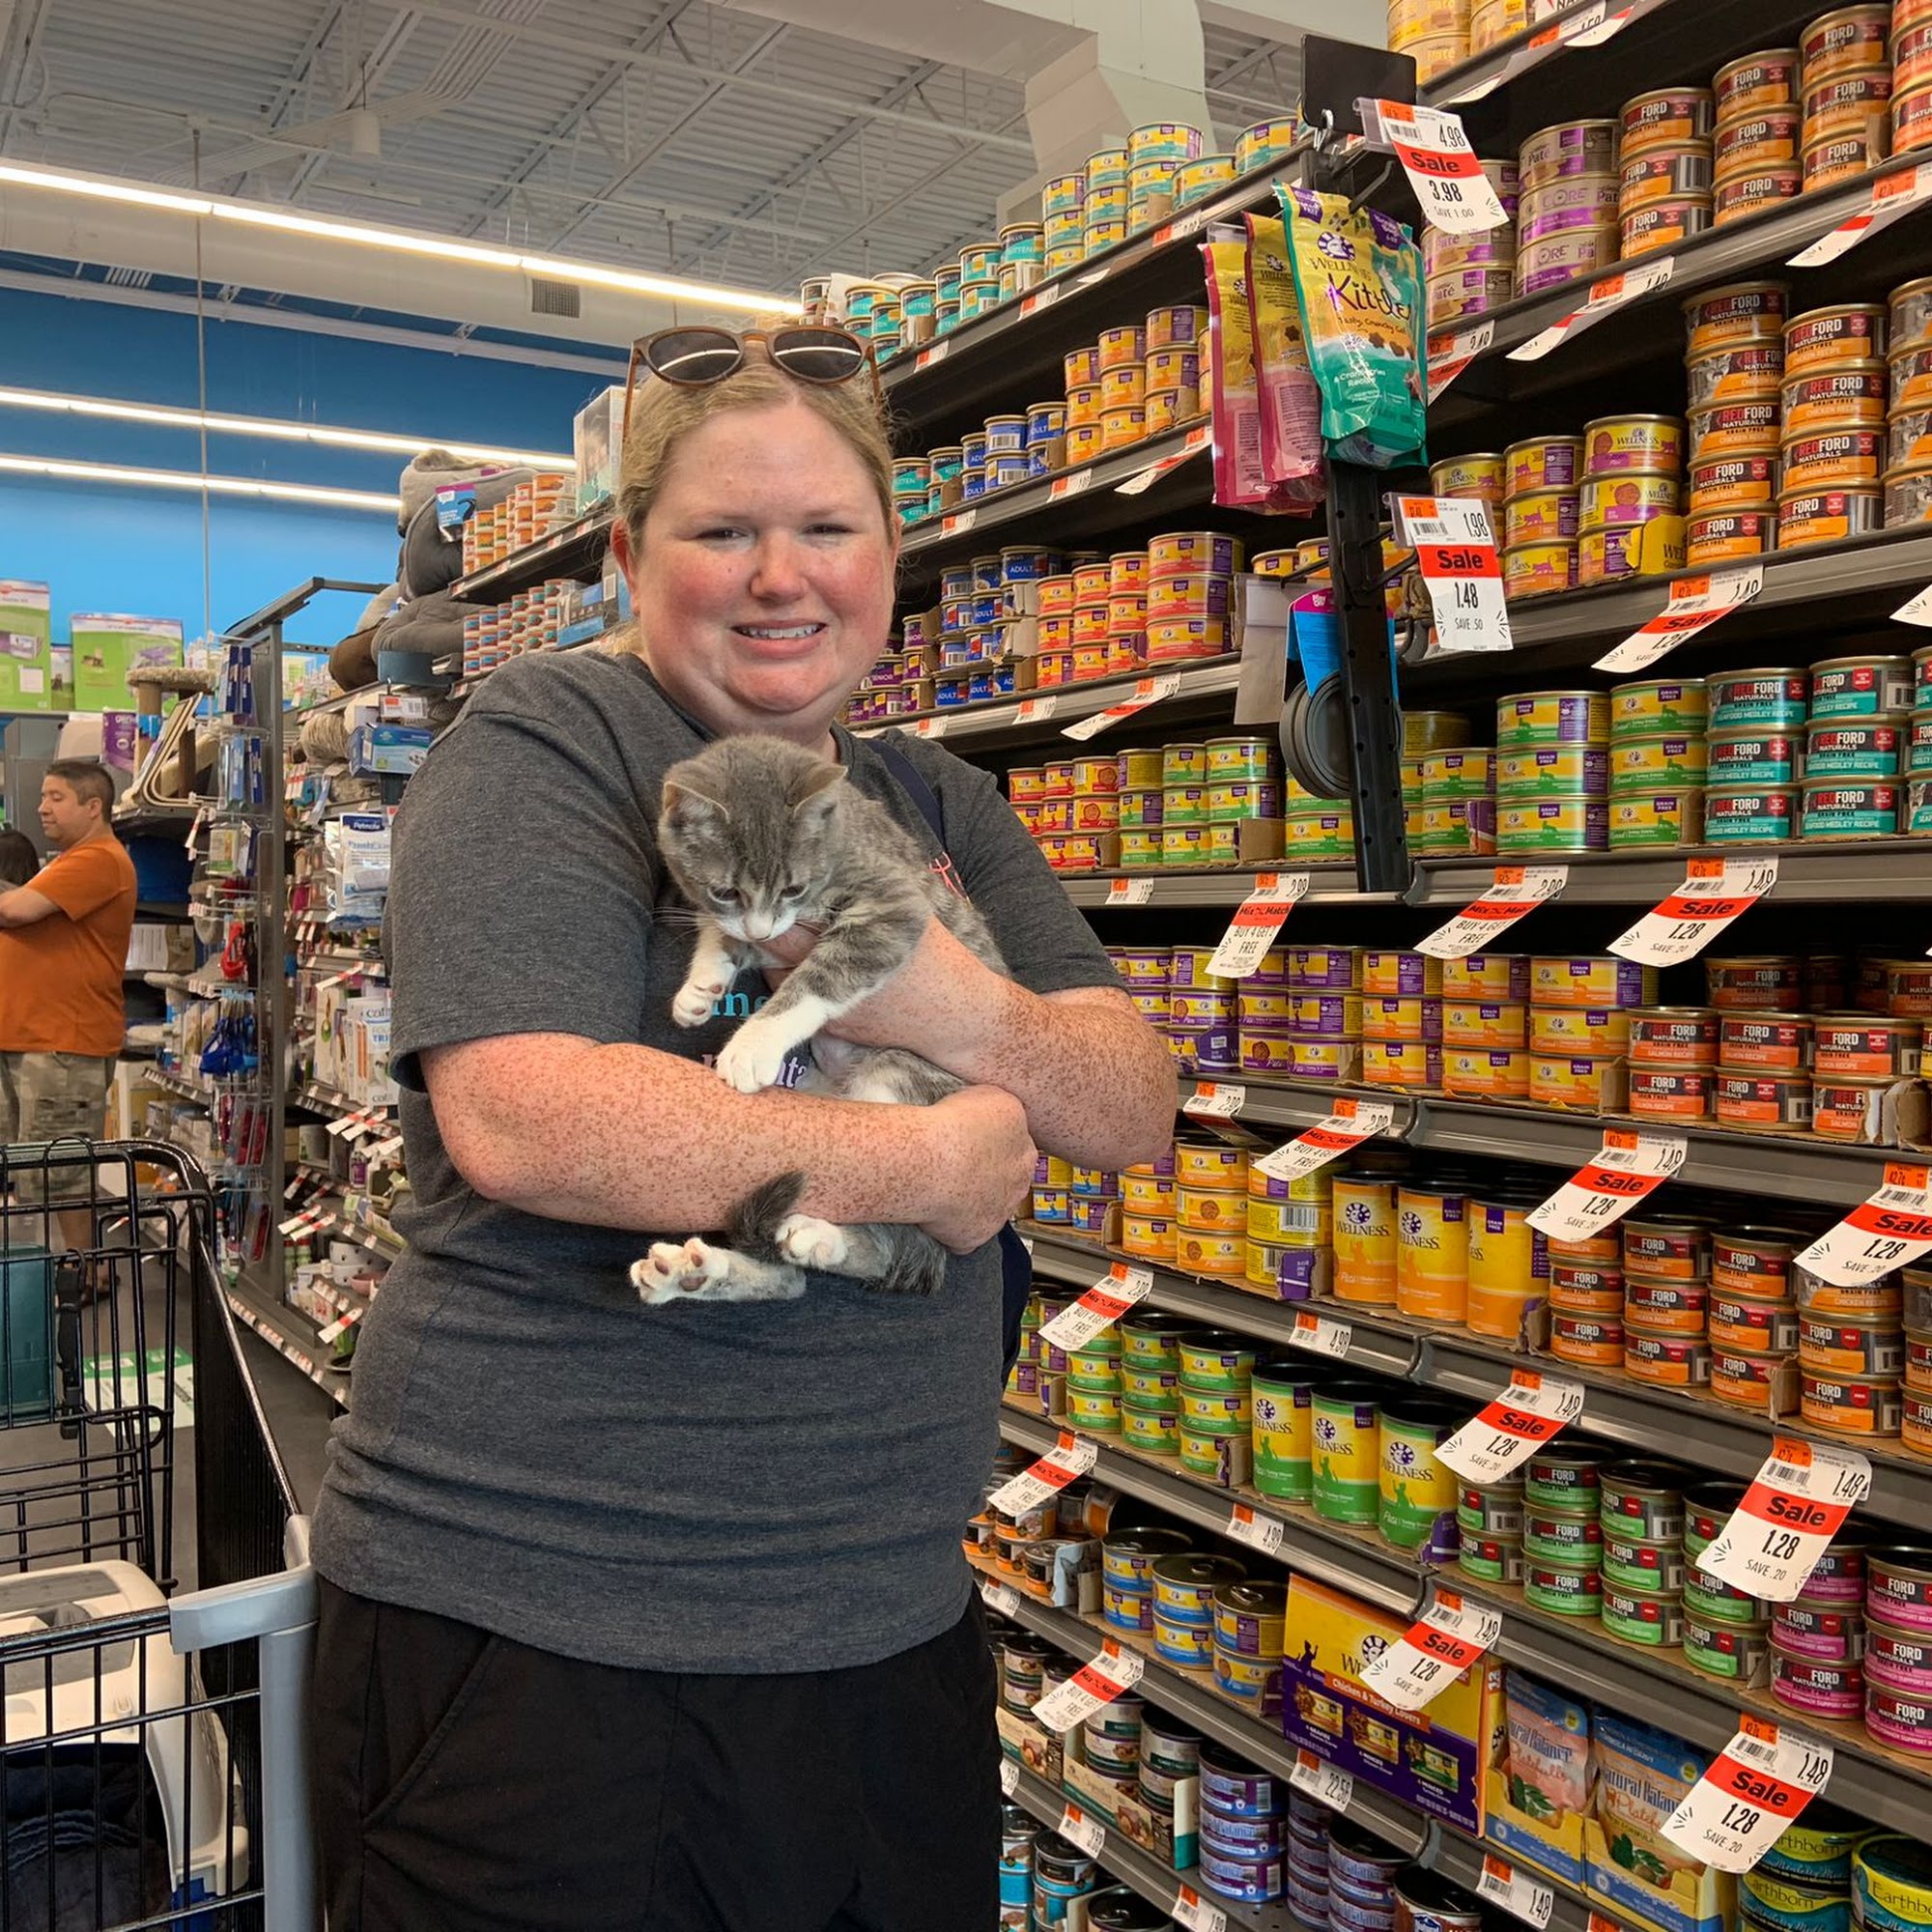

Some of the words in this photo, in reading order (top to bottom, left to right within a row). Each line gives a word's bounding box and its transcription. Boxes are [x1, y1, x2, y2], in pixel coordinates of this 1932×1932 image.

[1438, 125, 1466, 149] 4.98
[1410, 152, 1462, 173] Sale
[1429, 180, 1463, 203] 3.98
[1434, 205, 1454, 218] SAVE
[1454, 207, 1475, 218] 1.00
[1711, 307, 1753, 321] NATURALS
[1794, 320, 1843, 340] REDFORD
[1795, 333, 1834, 348] NATURALS
[1809, 377, 1864, 393] REDFORD
[1808, 390, 1857, 402] NATURALS
[1722, 406, 1774, 420] REDFORD
[1722, 419, 1766, 429] NATURALS
[1616, 435, 1660, 448] WELLNESS
[1800, 436, 1851, 455] REDFORD
[1799, 449, 1842, 464] NATURALS
[1699, 463, 1745, 482] REDFORD
[1463, 512, 1490, 539] 1.98
[1436, 549, 1483, 570] Sale
[1009, 564, 1035, 575] ADULT
[1454, 582, 1479, 609] 1.48
[1454, 618, 1473, 630] SAVE
[1663, 611, 1719, 630] Sale
[935, 689, 958, 700] ADULT
[1733, 682, 1782, 696] REDFORD
[1733, 694, 1775, 702] NATURALS
[1818, 730, 1865, 747] REDFORD
[1717, 742, 1761, 758] REDFORD
[1818, 742, 1858, 752] NATURALS
[1717, 753, 1752, 762] NATURALS
[1716, 798, 1760, 814] REDFORD
[1816, 790, 1865, 808] REDFORD
[1816, 802, 1857, 810] NATURALS
[1715, 809, 1752, 817] NATURALS
[1239, 905, 1254, 916] Mix
[1264, 905, 1290, 916] Match
[1467, 902, 1490, 917] Mix
[1678, 901, 1736, 917] Sale
[1234, 925, 1250, 938] BUY
[1455, 919, 1477, 930] BUY
[1667, 922, 1707, 940] 1.28
[1459, 932, 1489, 944] FREE
[1238, 941, 1259, 955] FREE
[1649, 943, 1674, 954] SAVE
[1652, 1024, 1697, 1037] REDFORD
[1652, 1034, 1690, 1042] NATURALS
[1307, 1127, 1325, 1141] Mix
[1293, 1144, 1311, 1155] BUY
[1293, 1157, 1320, 1170] FREE
[1593, 1172, 1644, 1192] Sale
[1580, 1196, 1618, 1216] 1.28
[1336, 1224, 1390, 1237] WELLNESS
[1563, 1216, 1585, 1230] SAVE
[1873, 1213, 1932, 1236] Sale
[1399, 1233, 1440, 1250] ELLNESS
[1861, 1237, 1908, 1261] 1.28
[1840, 1259, 1866, 1274] SAVE
[1070, 1321, 1093, 1334] FREE
[1554, 1392, 1581, 1416] 1.48
[1254, 1417, 1293, 1434] ELLNESS
[1498, 1410, 1545, 1435] Sale
[1486, 1434, 1520, 1459] 1.28
[1467, 1453, 1491, 1467] SAVE
[1381, 1460, 1436, 1482] WELLNESS
[1832, 1469, 1864, 1499] 1.48
[1765, 1495, 1827, 1527] Sale
[1761, 1528, 1801, 1561] 1.28
[1745, 1558, 1770, 1577] SAVE
[1770, 1568, 1787, 1585] .20
[1473, 1615, 1499, 1643] 1.48
[1424, 1633, 1465, 1661] Sale
[1409, 1658, 1441, 1684] 1.28
[1393, 1677, 1413, 1692] SAVE
[1332, 1677, 1361, 1695] Chicken
[1368, 1693, 1393, 1711] Turkey
[1392, 1705, 1423, 1727] Lovers
[1798, 1751, 1829, 1785] 1.48
[1730, 1770, 1789, 1807] Sale
[1719, 1803, 1761, 1836] 1.28
[1702, 1828, 1725, 1849] SAVE
[1725, 1839, 1743, 1855] .20
[1776, 1833, 1841, 1855] arthborn
[1529, 1888, 1552, 1921] 1.48
[1871, 1880, 1932, 1915] Earthbo
